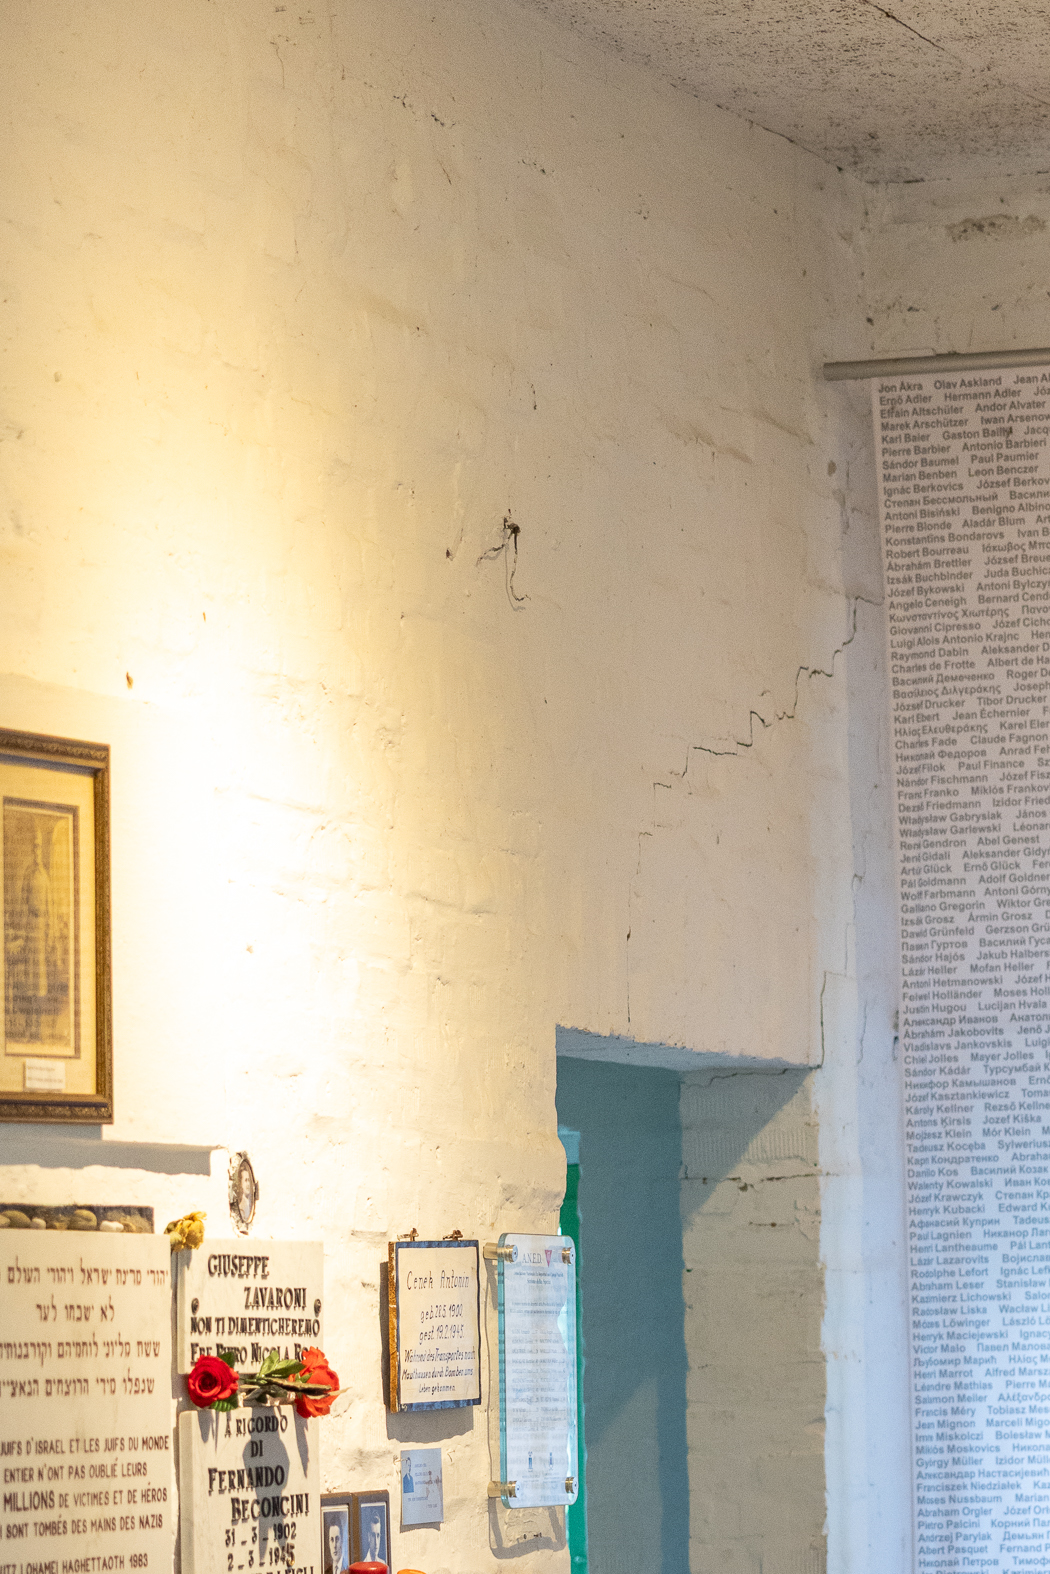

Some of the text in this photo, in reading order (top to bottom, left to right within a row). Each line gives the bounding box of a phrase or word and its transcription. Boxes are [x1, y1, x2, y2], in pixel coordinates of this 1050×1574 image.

[1013, 375, 1039, 385] Jean
[944, 388, 1021, 401] Hermann Adler
[208, 1254, 269, 1279] GIUSEPPE
[101, 1294, 114, 1321] לא
[244, 1287, 307, 1310] ZAVARONI
[191, 1316, 320, 1337] NON TI DIMENTICHEREMO
[236, 1415, 288, 1437] RICORDO
[70, 1439, 80, 1454] ET
[84, 1438, 100, 1453] LES
[104, 1437, 125, 1452] JUIFS
[129, 1436, 139, 1451] DU
[142, 1435, 169, 1451] MONDE
[250, 1440, 264, 1458] DI
[4, 1467, 34, 1484] ENTIER
[68, 1464, 86, 1479] PAS
[89, 1457, 118, 1478] OUBLIÉ
[121, 1462, 147, 1477] LEURS
[208, 1465, 285, 1496] FERNANDO
[3, 1482, 167, 1513] MILLIONS DE VICTIMES ET DE HÉROS
[231, 1493, 309, 1523] BECONCINI
[6, 1514, 163, 1540] SONT TOMBÉS DES MAINS DES NAZIS
[273, 1521, 297, 1541] 1902
[62, 1555, 125, 1574] HAGHETTAOTH
